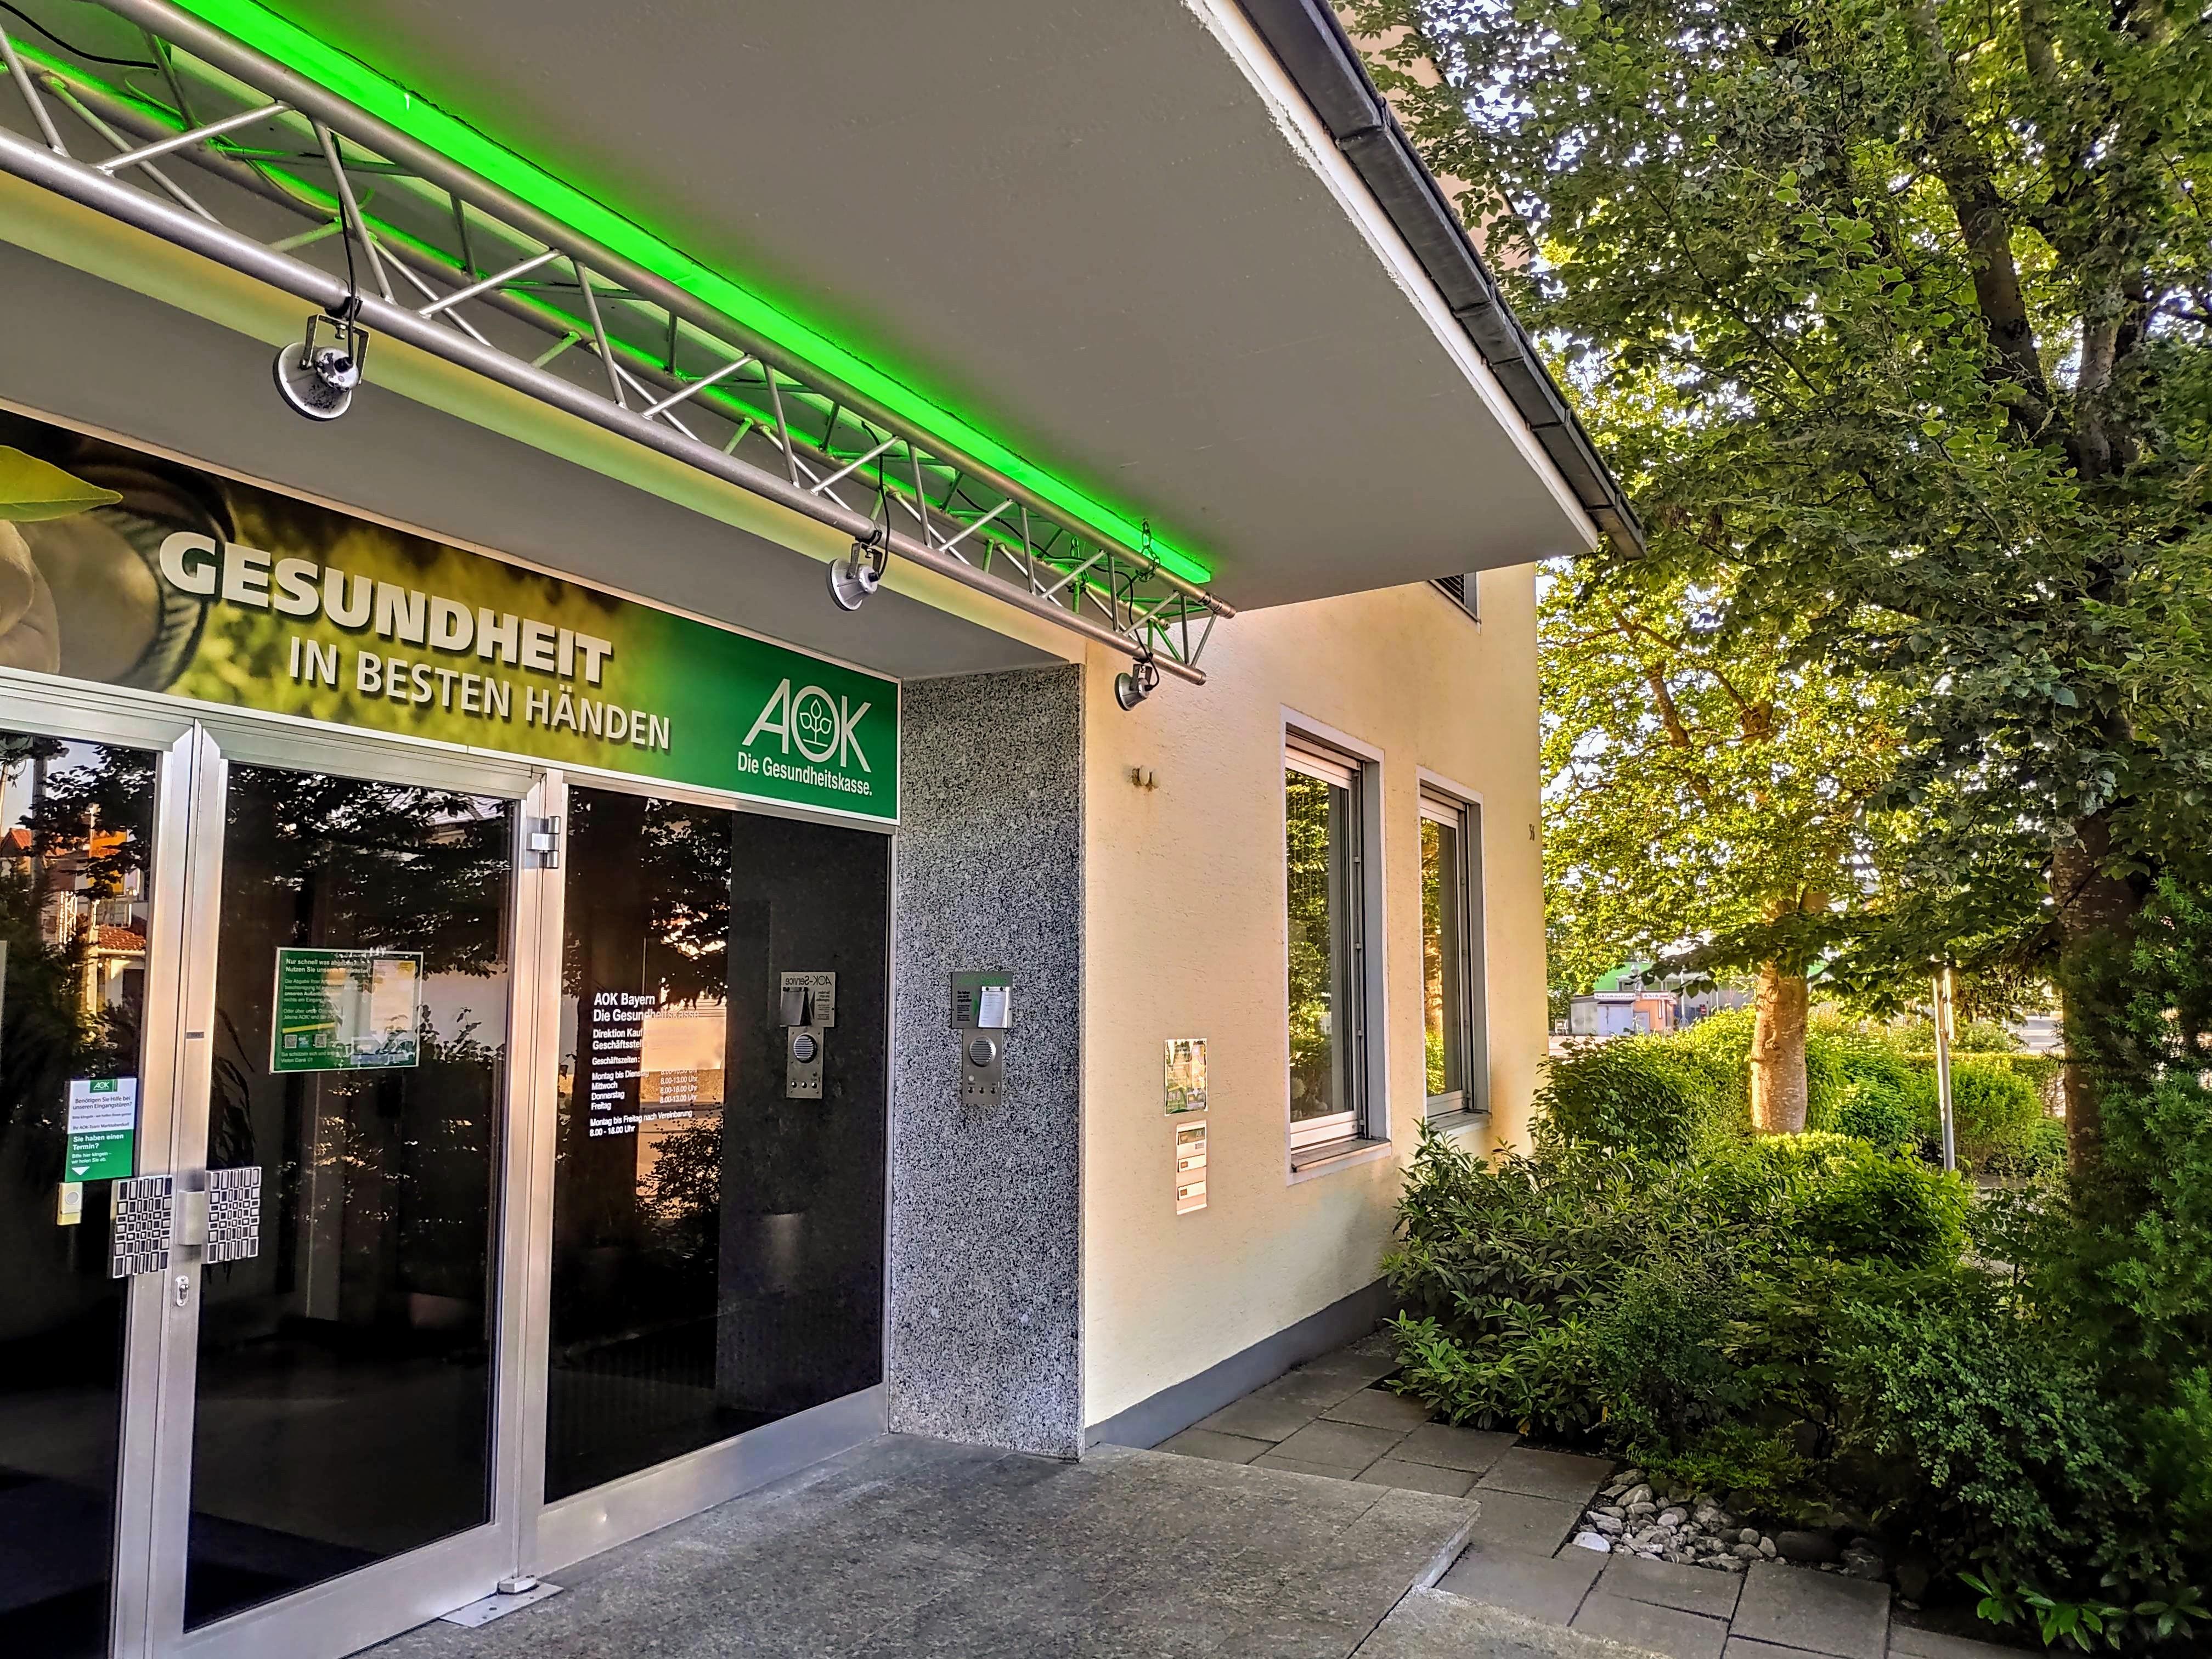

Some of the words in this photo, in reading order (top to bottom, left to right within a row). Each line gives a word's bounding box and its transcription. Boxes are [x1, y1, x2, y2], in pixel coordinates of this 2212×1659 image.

[159, 530, 612, 684] GESUNDHEIT
[289, 636, 337, 685] IN
[357, 651, 510, 718] BESTEN
[526, 684, 670, 749] HÄNDEN
[742, 679, 871, 773] AOK
[737, 752, 759, 774] Die
[762, 757, 873, 796] Gesundheitskasse.
[594, 992, 618, 1006] AOK
[621, 992, 655, 1008] Bayern
[593, 1009, 611, 1022] Die
[592, 1029, 625, 1039] Direktion
[592, 1072, 614, 1081] Montag
[591, 1081, 618, 1090] Mittwoch
[591, 1091, 625, 1101] Donnerstag
[660, 1086, 687, 1094] 8.00-18.00
[659, 1094, 687, 1103] 8.00-13.00
[590, 1118, 612, 1126] Montag
[613, 1116, 622, 1125] bis
[623, 1115, 642, 1124] Freitag
[658, 1110, 692, 1119] Vereinbarung
[589, 1128, 603, 1137] 8.00
